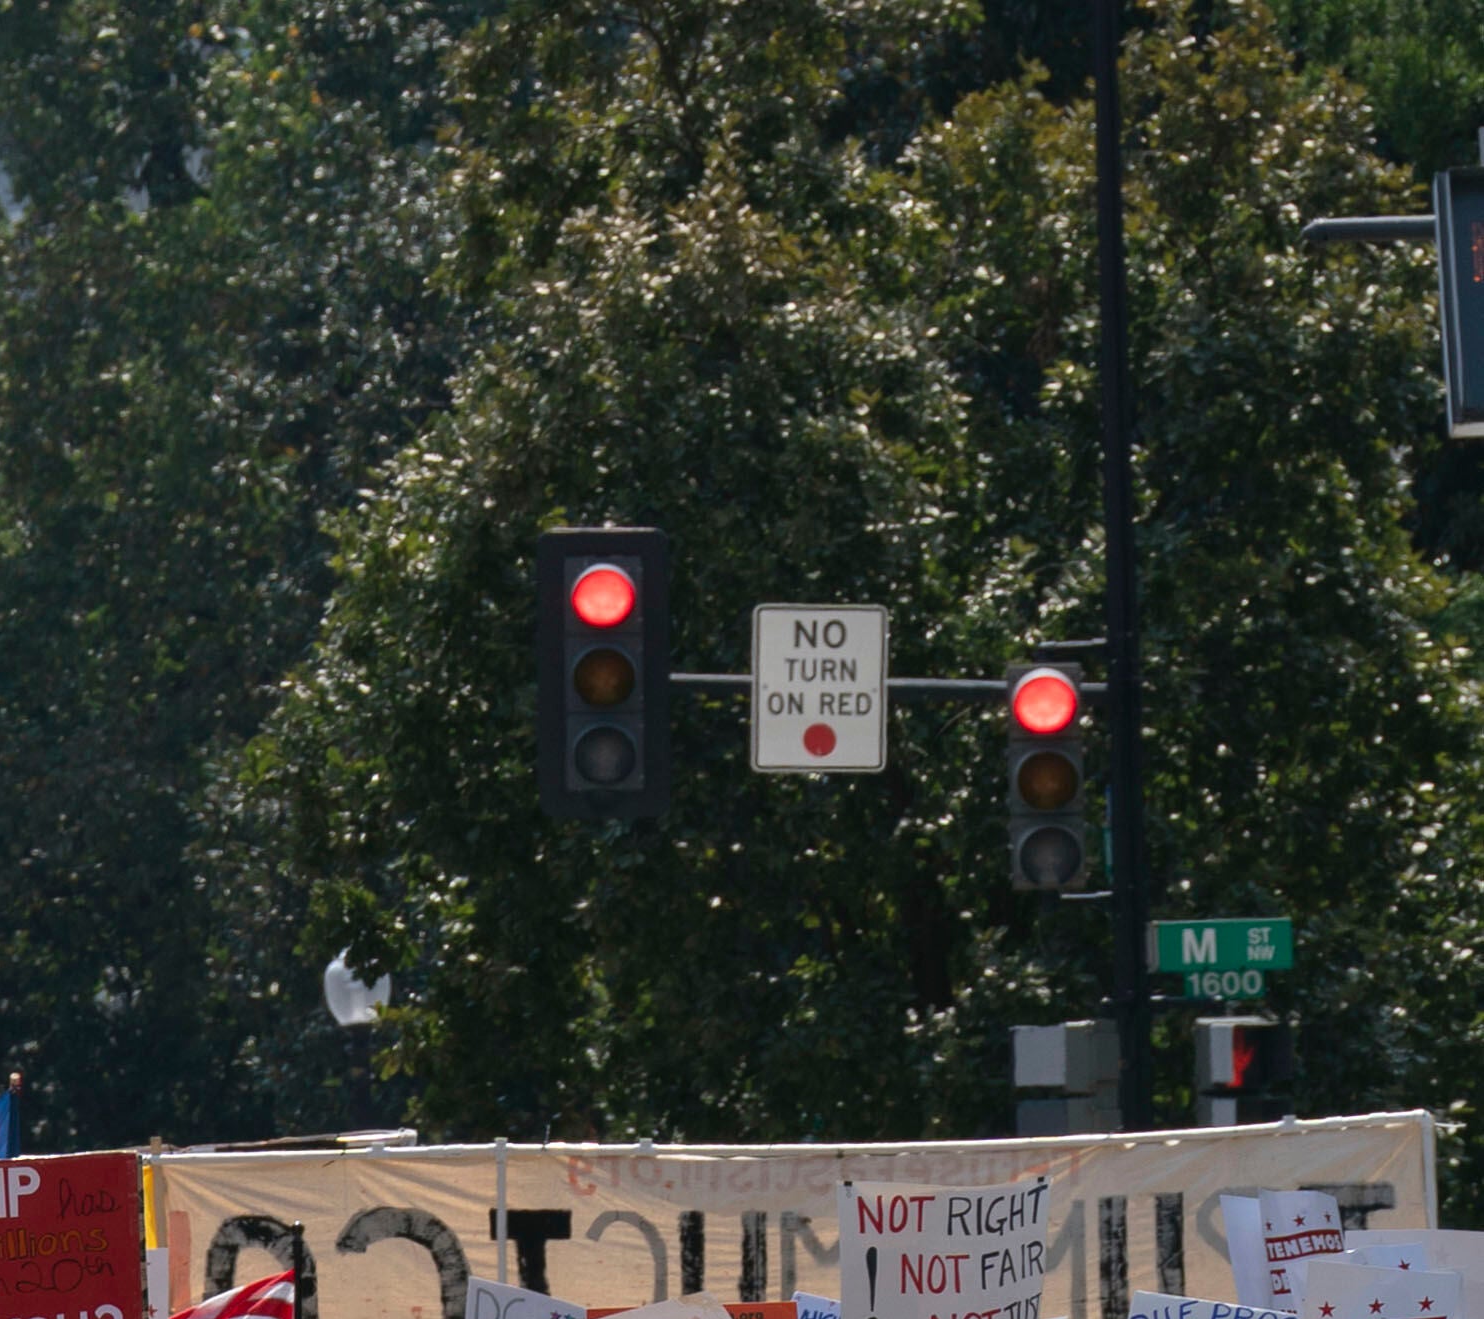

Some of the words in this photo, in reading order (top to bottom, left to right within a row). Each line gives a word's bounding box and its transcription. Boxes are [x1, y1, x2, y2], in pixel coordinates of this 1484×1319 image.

[794, 620, 847, 648] NO
[785, 659, 856, 682] TURN
[767, 692, 804, 715] ON
[820, 692, 872, 716] RED
[1182, 927, 1217, 964] M
[1248, 927, 1271, 944] ST
[1247, 945, 1275, 961] NW
[1188, 970, 1263, 997] 1600
[57, 1180, 120, 1219] has
[857, 1195, 935, 1234] NOT
[947, 1184, 1048, 1236] RIGHT
[1266, 1234, 1341, 1261] TENEMOS
[14, 1259, 115, 1295] 20th
[901, 1253, 969, 1294] NOT
[981, 1241, 1043, 1290] FAIR
